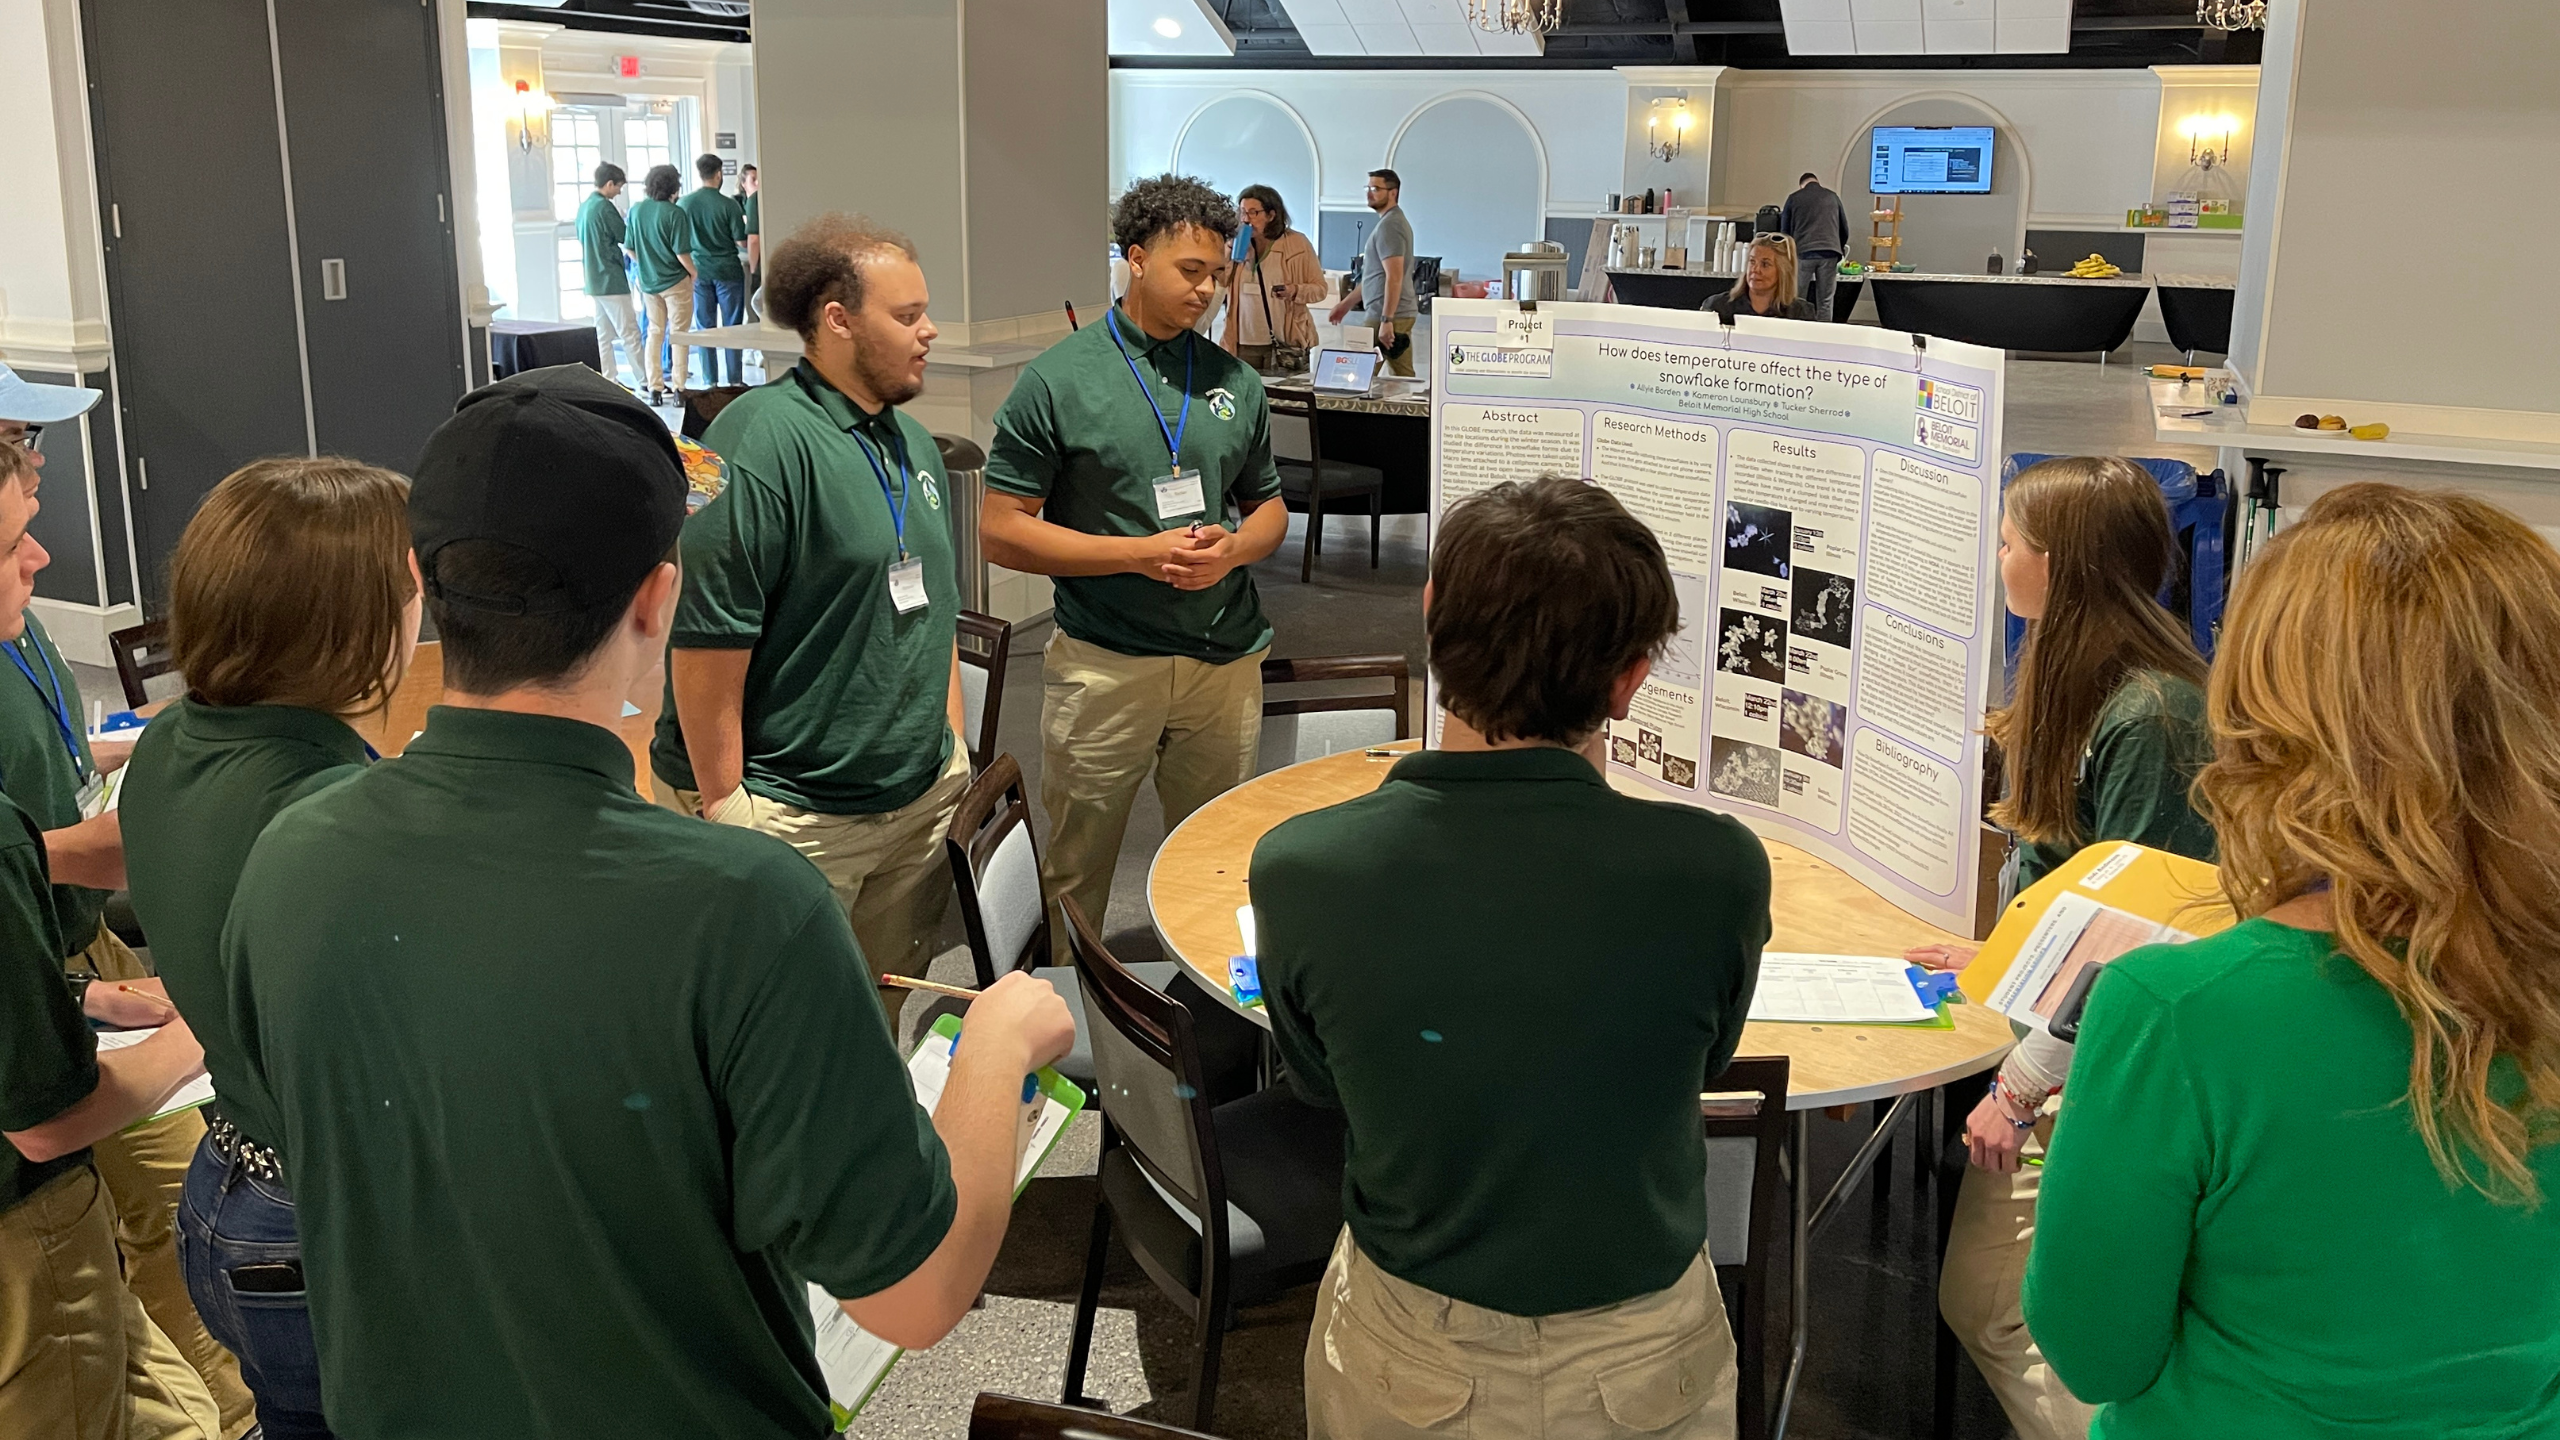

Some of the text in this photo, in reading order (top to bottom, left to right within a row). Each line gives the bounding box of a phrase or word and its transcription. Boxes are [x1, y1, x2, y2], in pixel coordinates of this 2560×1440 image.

[1508, 320, 1542, 330] Project
[1466, 352, 1550, 364] THE GLOBE PROGRAM
[1599, 343, 1887, 388] How does temperature affect the type of
[1659, 372, 1813, 400] snowflake formation?
[1655, 386, 1681, 397] Borden
[1692, 391, 1728, 402] Kameron
[1730, 395, 1771, 409] Lounsbury
[1781, 402, 1806, 412] Tucker
[1809, 404, 1844, 416] Sherrod
[1678, 400, 1789, 421] Beloit Memorial High School
[1934, 394, 1976, 418] BELOIT
[1482, 410, 1538, 423] Abstract
[1931, 421, 1953, 434] BELOIT
[1604, 417, 1707, 442] Research Methods
[1931, 431, 1970, 450] MEMORIAL
[1773, 441, 1816, 458] Results
[1900, 458, 1949, 485] Discussion
[1885, 614, 1944, 649] Conclusions
[1875, 738, 1939, 782] Bibliography
